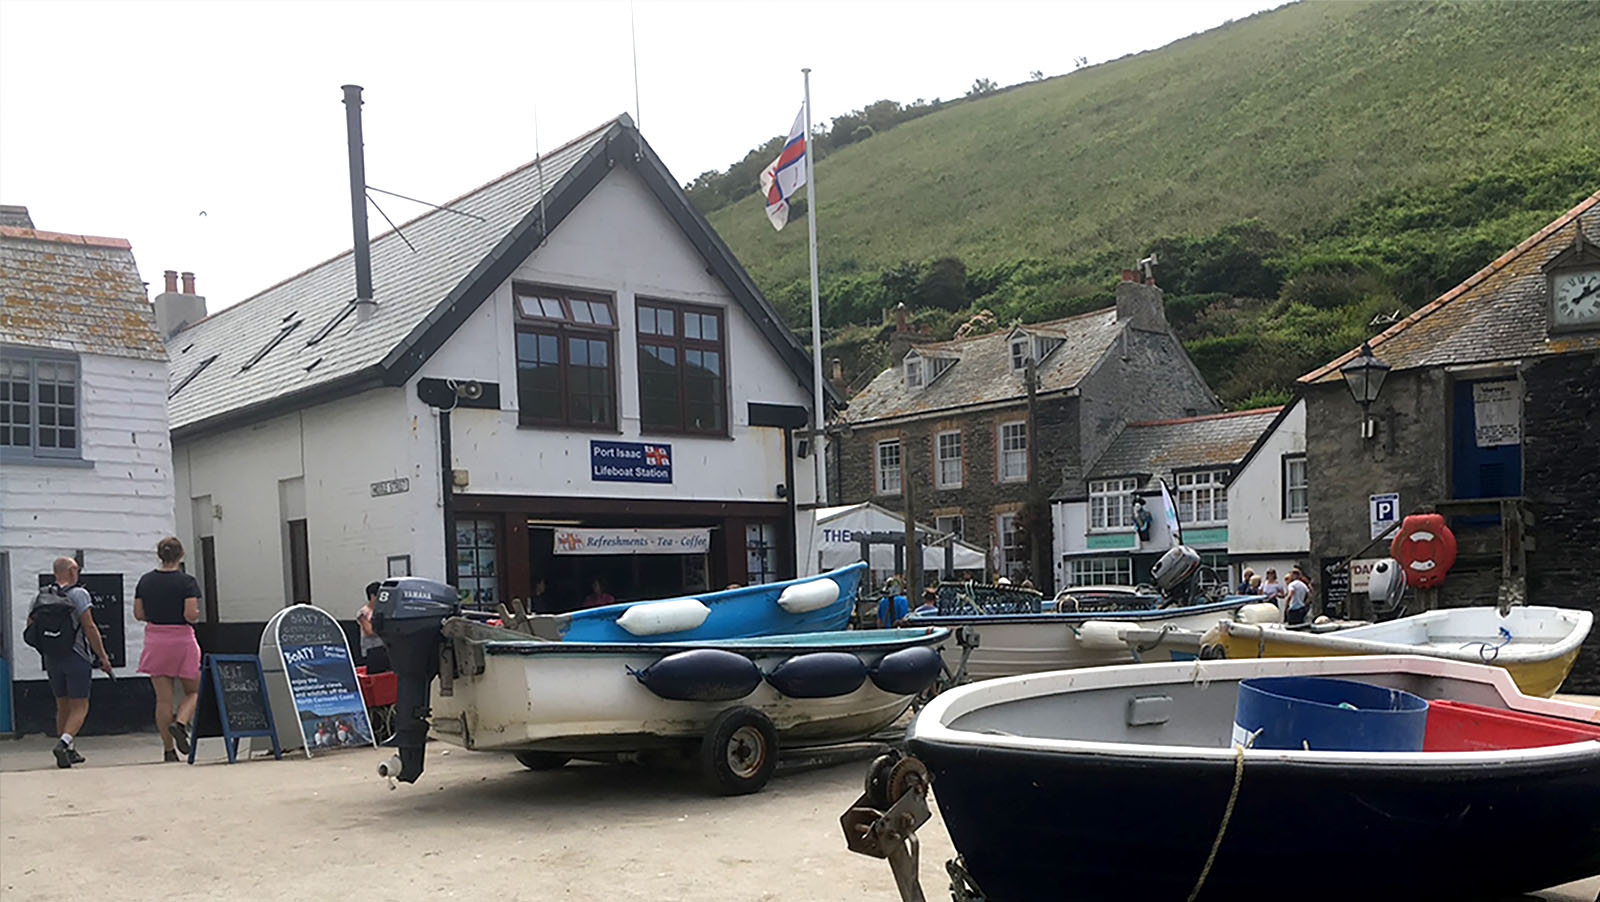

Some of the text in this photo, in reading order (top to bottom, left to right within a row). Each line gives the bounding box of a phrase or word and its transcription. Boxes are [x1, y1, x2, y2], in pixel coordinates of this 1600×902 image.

[593, 446, 642, 459] Port Isaac
[594, 465, 669, 478] Lifeboat Station
[1379, 502, 1391, 520] P
[586, 535, 649, 548] Refreshments
[656, 536, 673, 547] Tea
[680, 536, 707, 548] Coffee
[823, 529, 851, 543] THE
[379, 591, 390, 602] 8
[403, 591, 432, 600] YAMAHA
